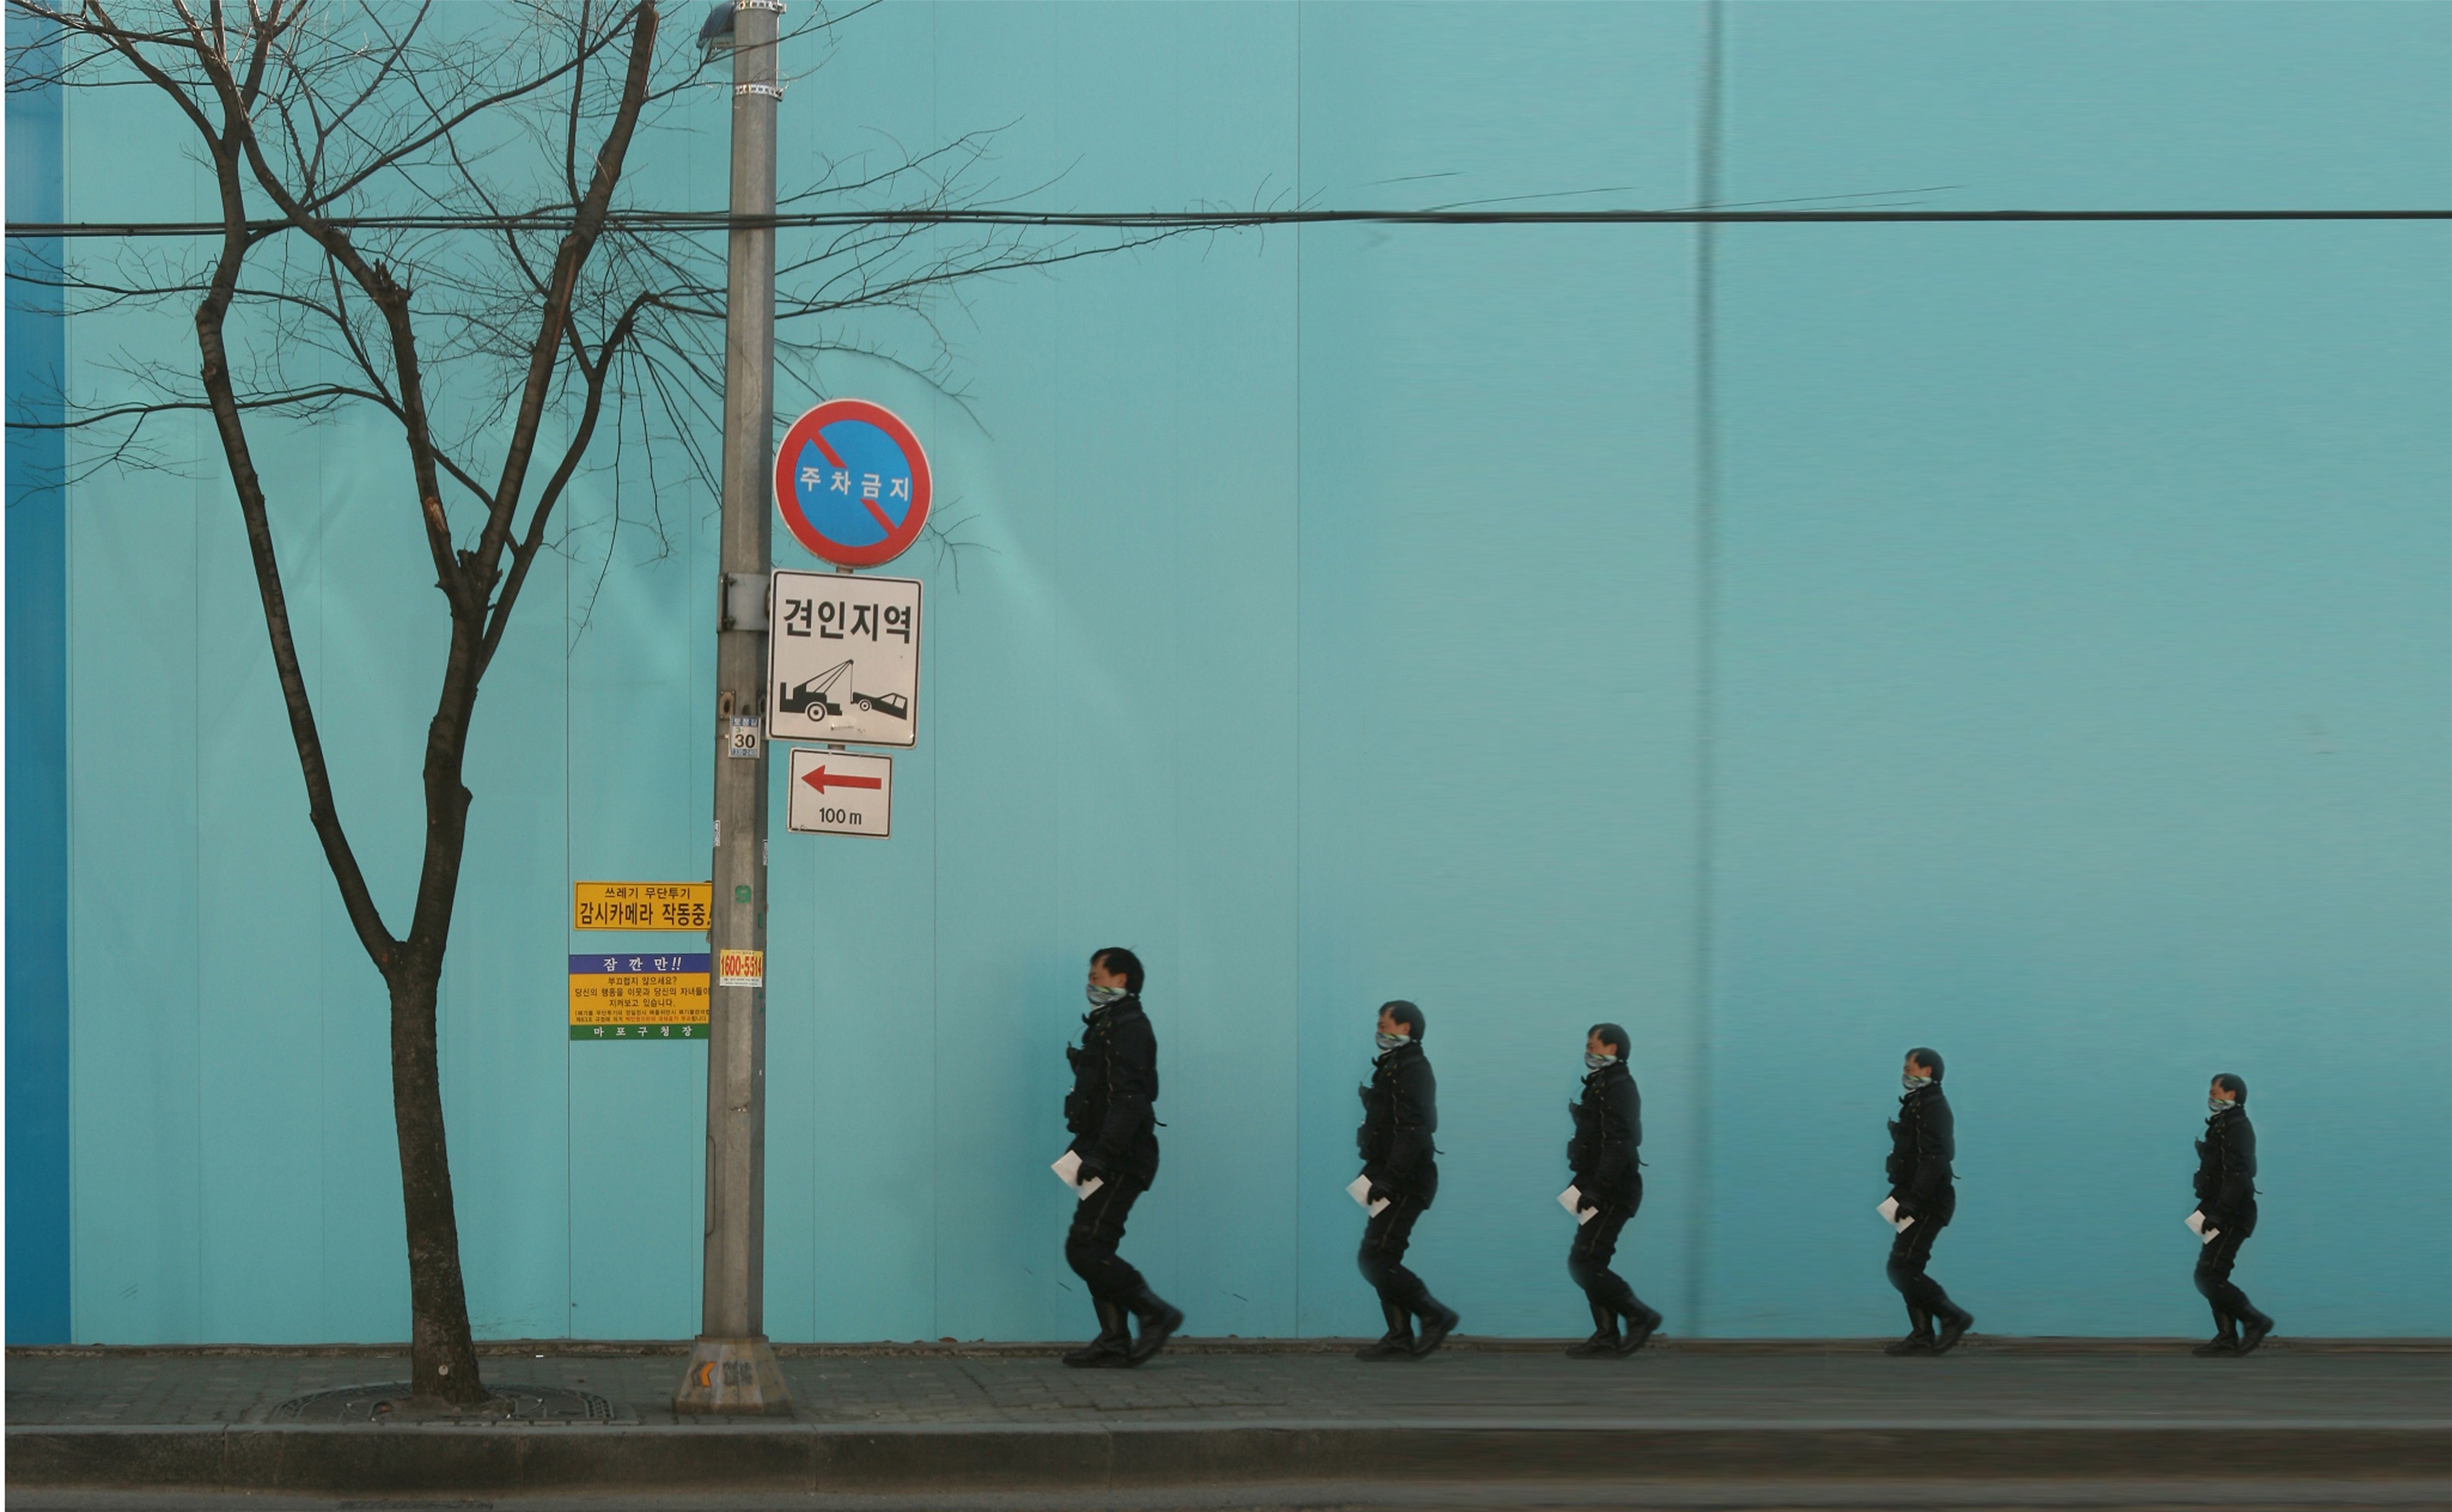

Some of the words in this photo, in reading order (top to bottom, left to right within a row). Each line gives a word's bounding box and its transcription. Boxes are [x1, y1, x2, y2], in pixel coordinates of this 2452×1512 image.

[784, 599, 911, 644] 견인지역
[735, 734, 755, 748] 30
[819, 807, 846, 823] 100
[850, 812, 862, 825] m
[605, 887, 639, 900] 쓰레기
[645, 887, 690, 900] 무단투기
[580, 902, 653, 925] 감시카메라
[721, 955, 762, 977] 1600-5514
[608, 977, 639, 986] 부끄럽지
[642, 976, 677, 986] 않으세요?
[575, 988, 598, 997] 당신의
[602, 988, 623, 997] 행동을
[628, 988, 650, 997] 이웃과
[654, 987, 676, 997] 당신의
[609, 999, 639, 1008] 지켜보고
[643, 998, 675, 1008] 있습니다.
